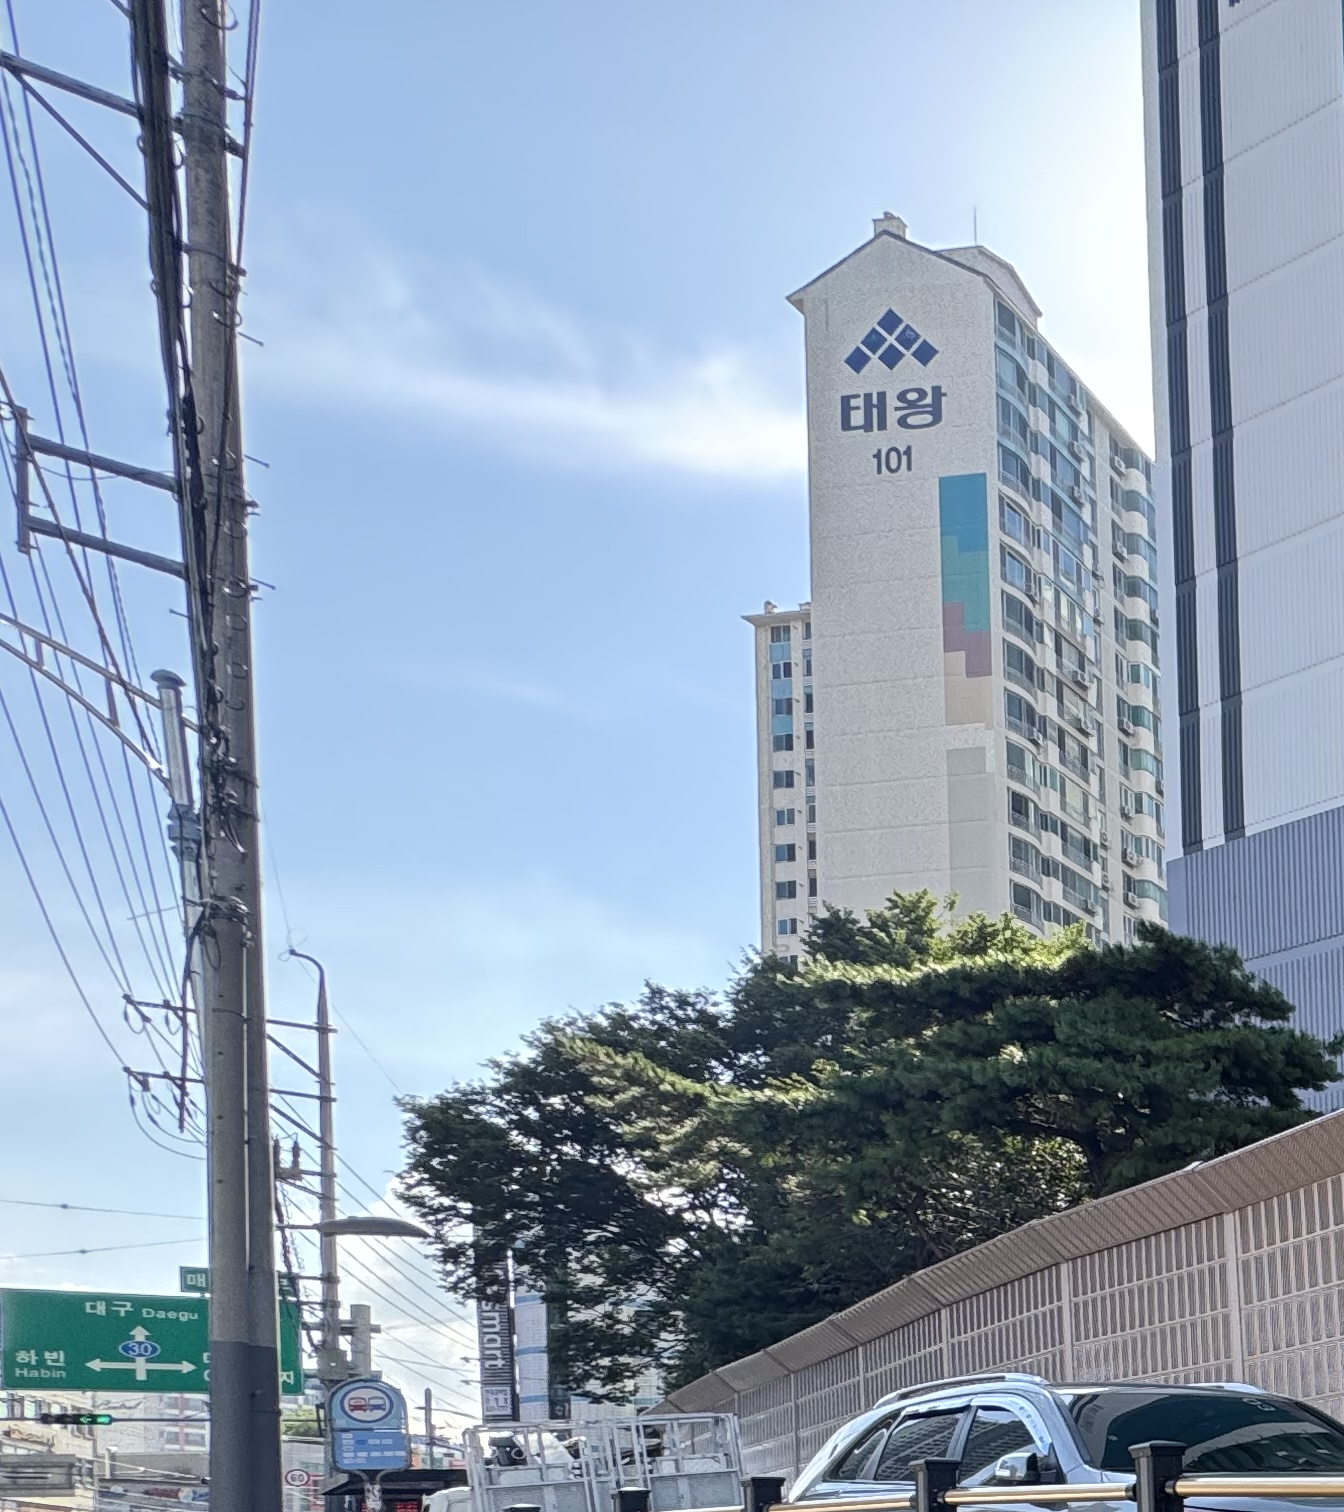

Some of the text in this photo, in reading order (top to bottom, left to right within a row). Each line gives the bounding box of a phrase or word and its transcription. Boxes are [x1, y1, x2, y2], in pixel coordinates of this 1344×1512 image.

[840, 385, 947, 433] 태왕
[872, 446, 913, 476] 101
[85, 1300, 199, 1321] 대구 Daegu
[127, 1342, 153, 1356] 30
[15, 1350, 67, 1368] 하빈
[15, 1368, 67, 1379] Habin
